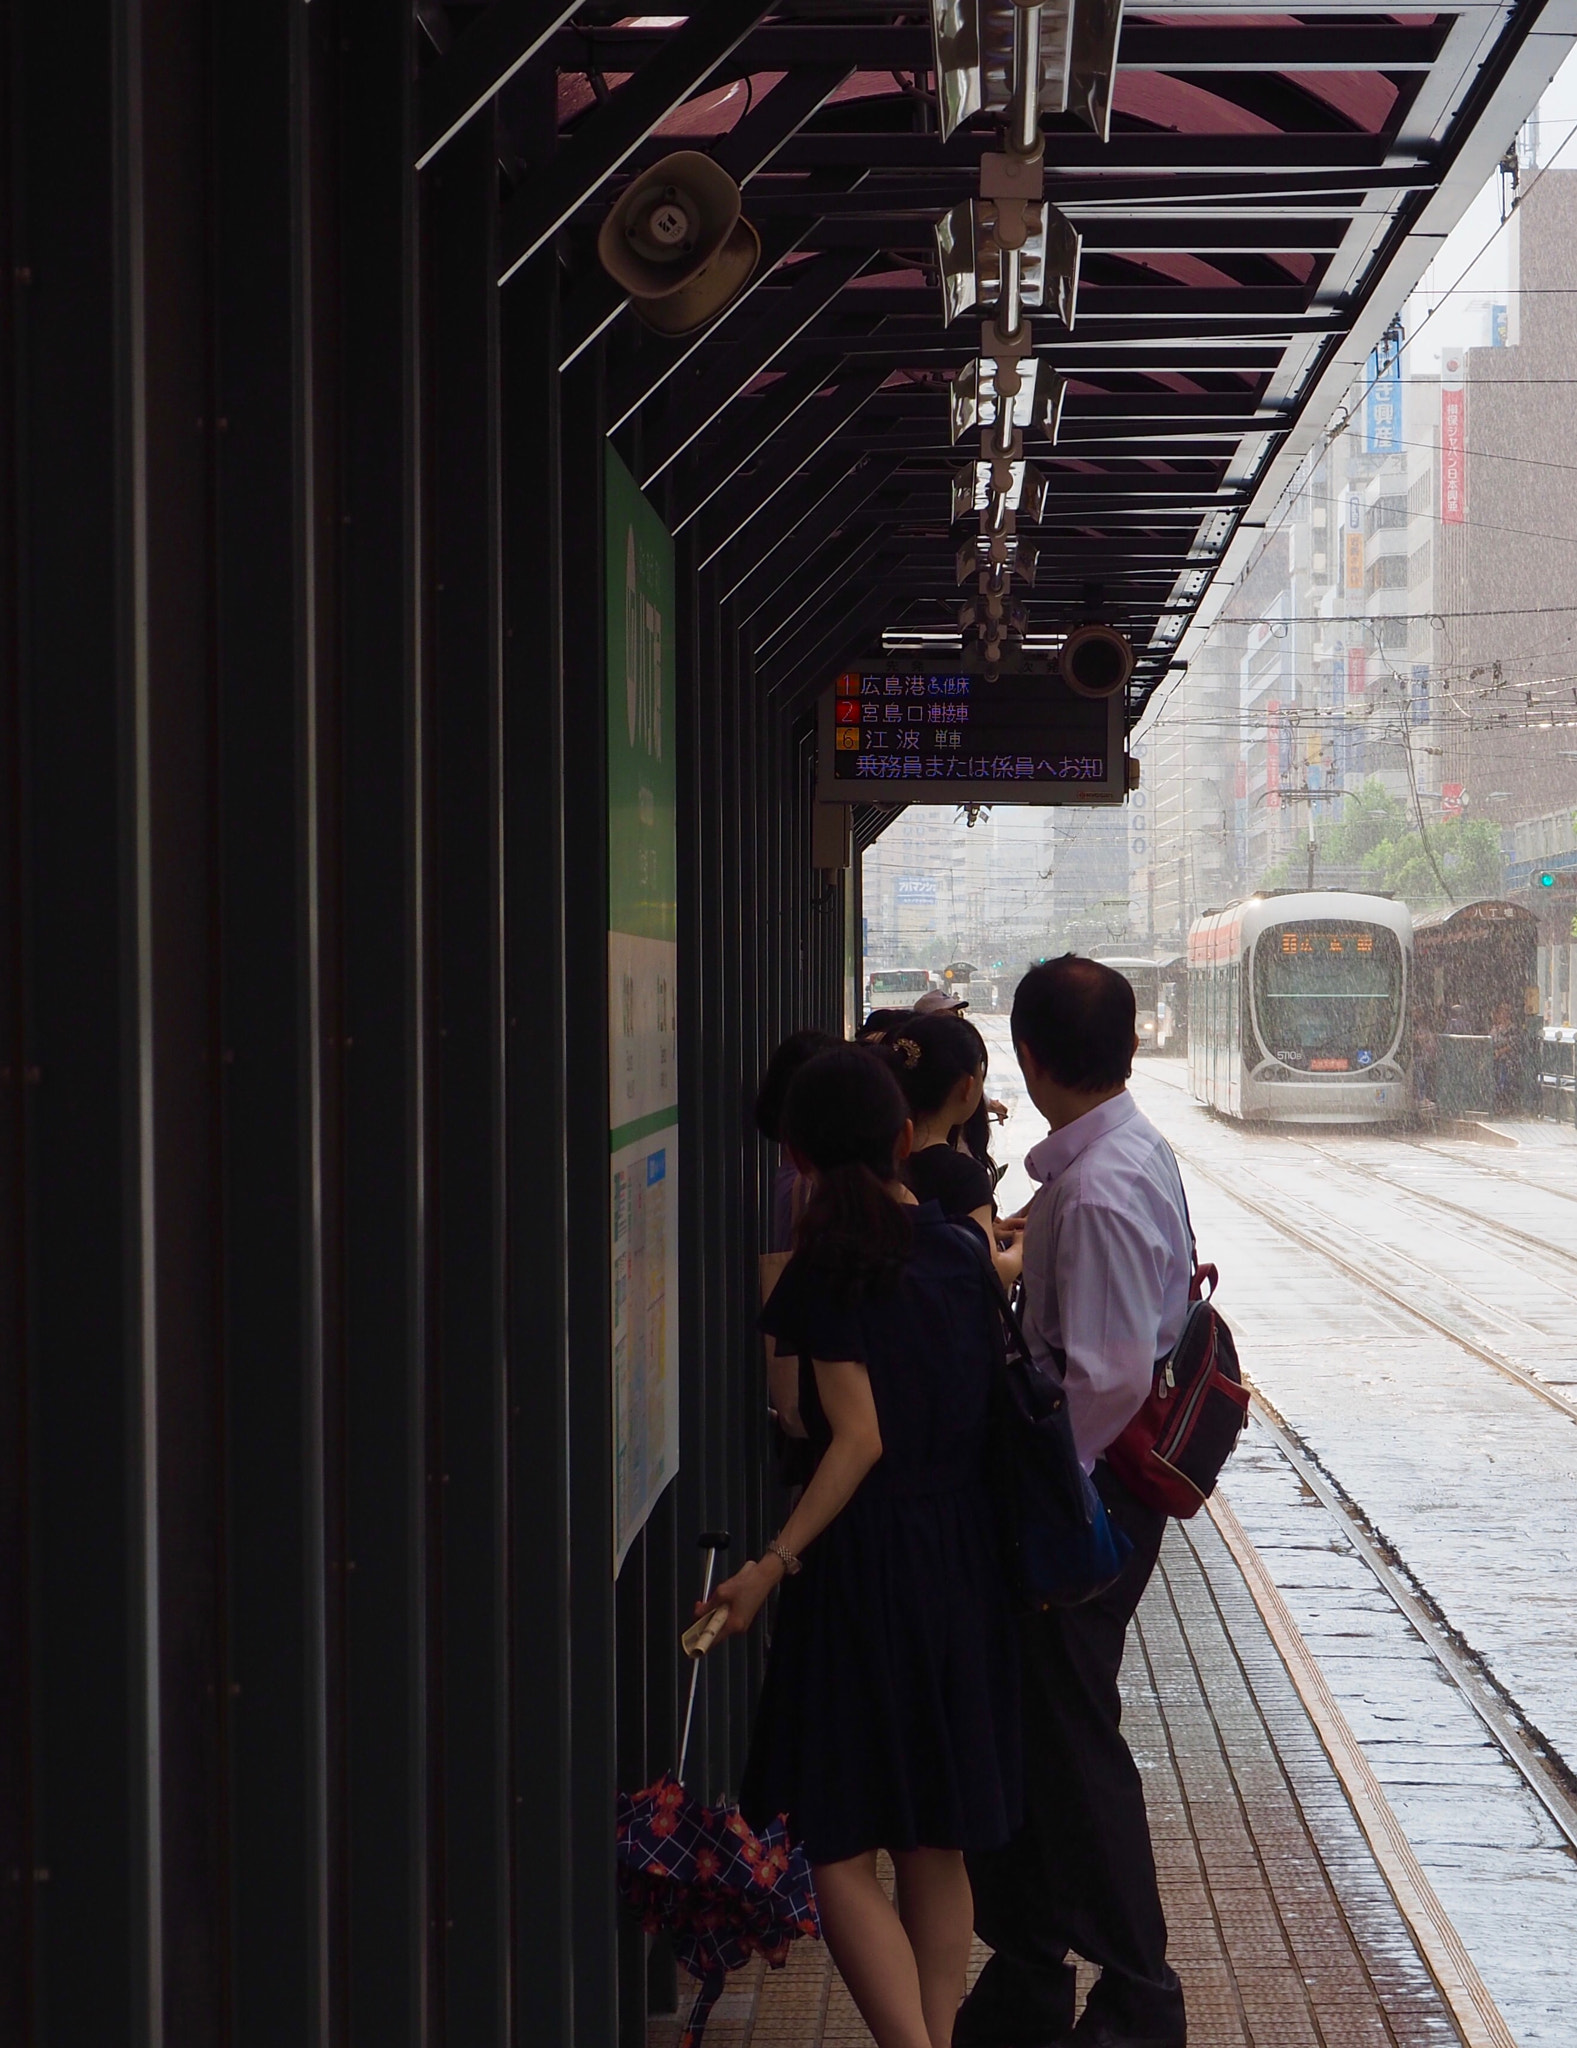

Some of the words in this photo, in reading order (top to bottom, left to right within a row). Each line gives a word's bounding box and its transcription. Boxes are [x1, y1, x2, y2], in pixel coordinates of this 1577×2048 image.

[860, 676, 925, 695] 広島港
[861, 702, 923, 723] 宮島口
[927, 702, 969, 723] 連接車
[865, 729, 920, 749] 江波
[934, 729, 962, 749] 単車
[856, 755, 1103, 779] 乗務員または係員へお知
[1132, 769, 1147, 854] OGO
[1474, 908, 1513, 918] 八丁堀
